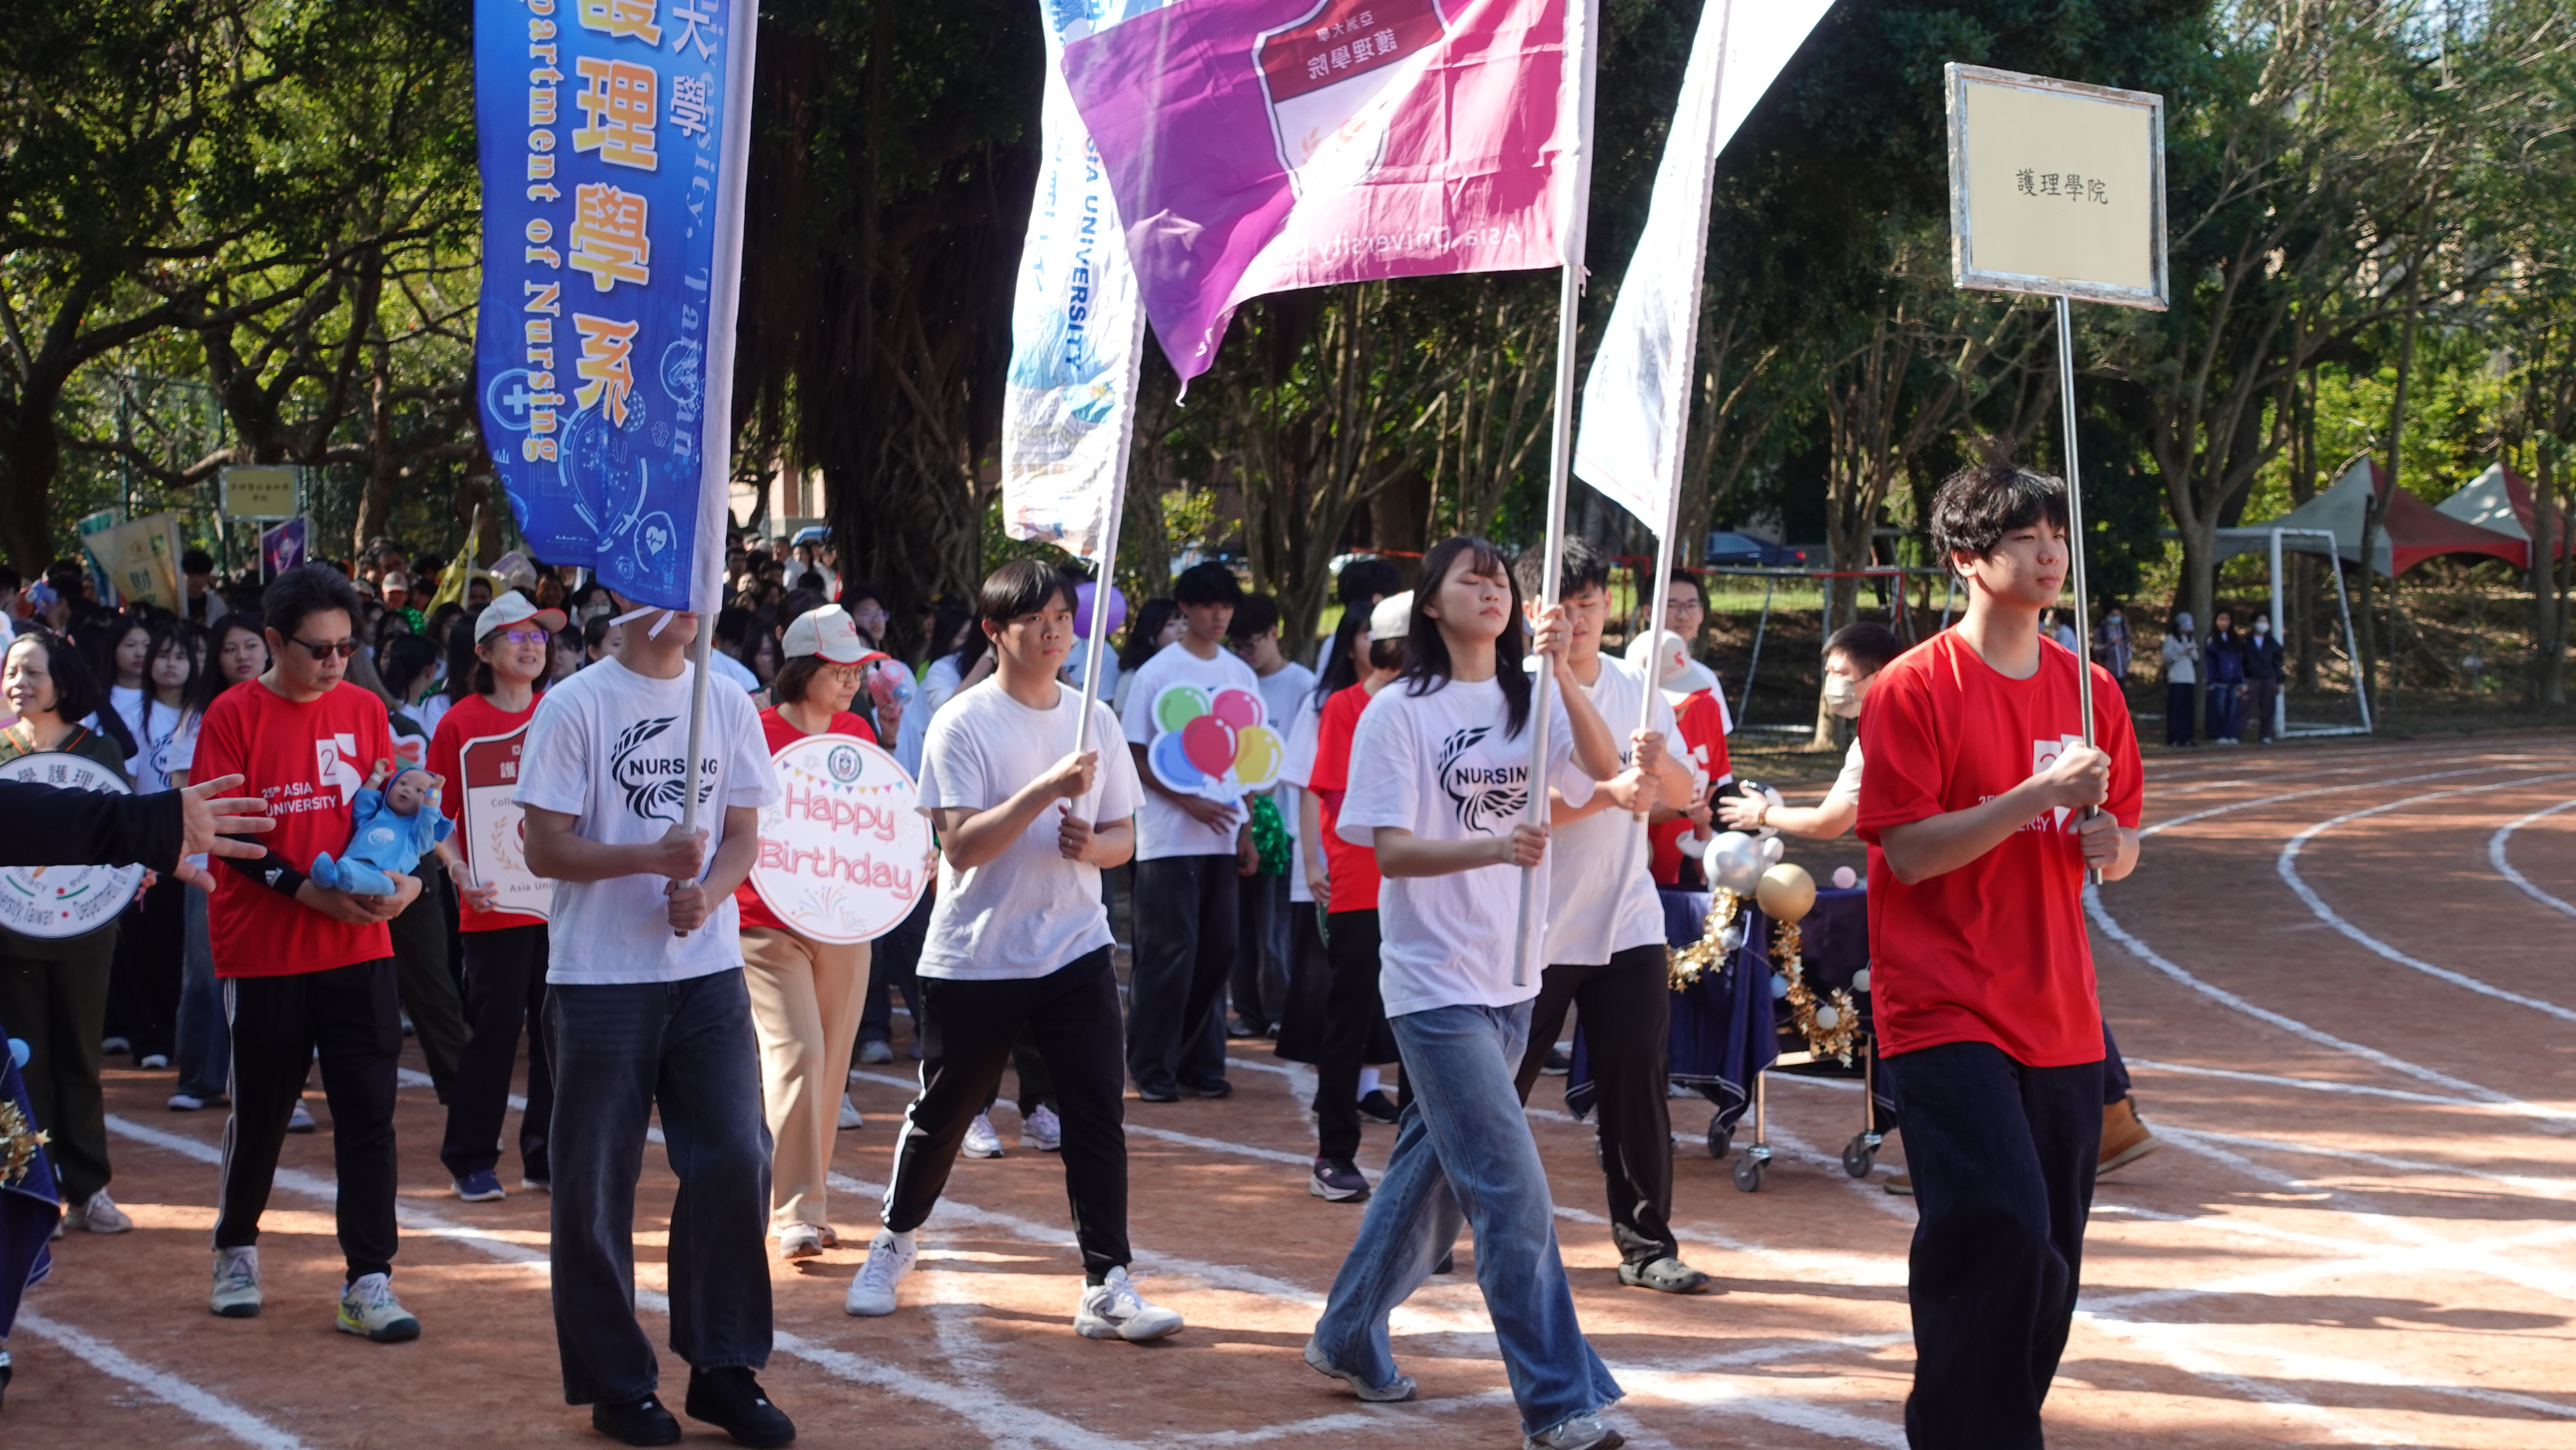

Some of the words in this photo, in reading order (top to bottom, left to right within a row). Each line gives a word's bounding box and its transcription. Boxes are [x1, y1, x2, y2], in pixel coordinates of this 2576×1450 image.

[1086, 136, 1100, 184] SIA
[2016, 167, 2108, 204] 護理學院
[525, 218, 561, 269] of
[1066, 195, 1099, 372] UNIVERSITY
[523, 281, 565, 463] Nursing
[629, 758, 718, 776] NURSNG
[1456, 765, 1530, 785] NURSIN
[265, 795, 337, 817] UNIVERSITY
[283, 781, 314, 798] ASIA
[491, 796, 511, 807] Coll
[786, 781, 896, 841] Happy
[758, 836, 913, 900] Birthday
